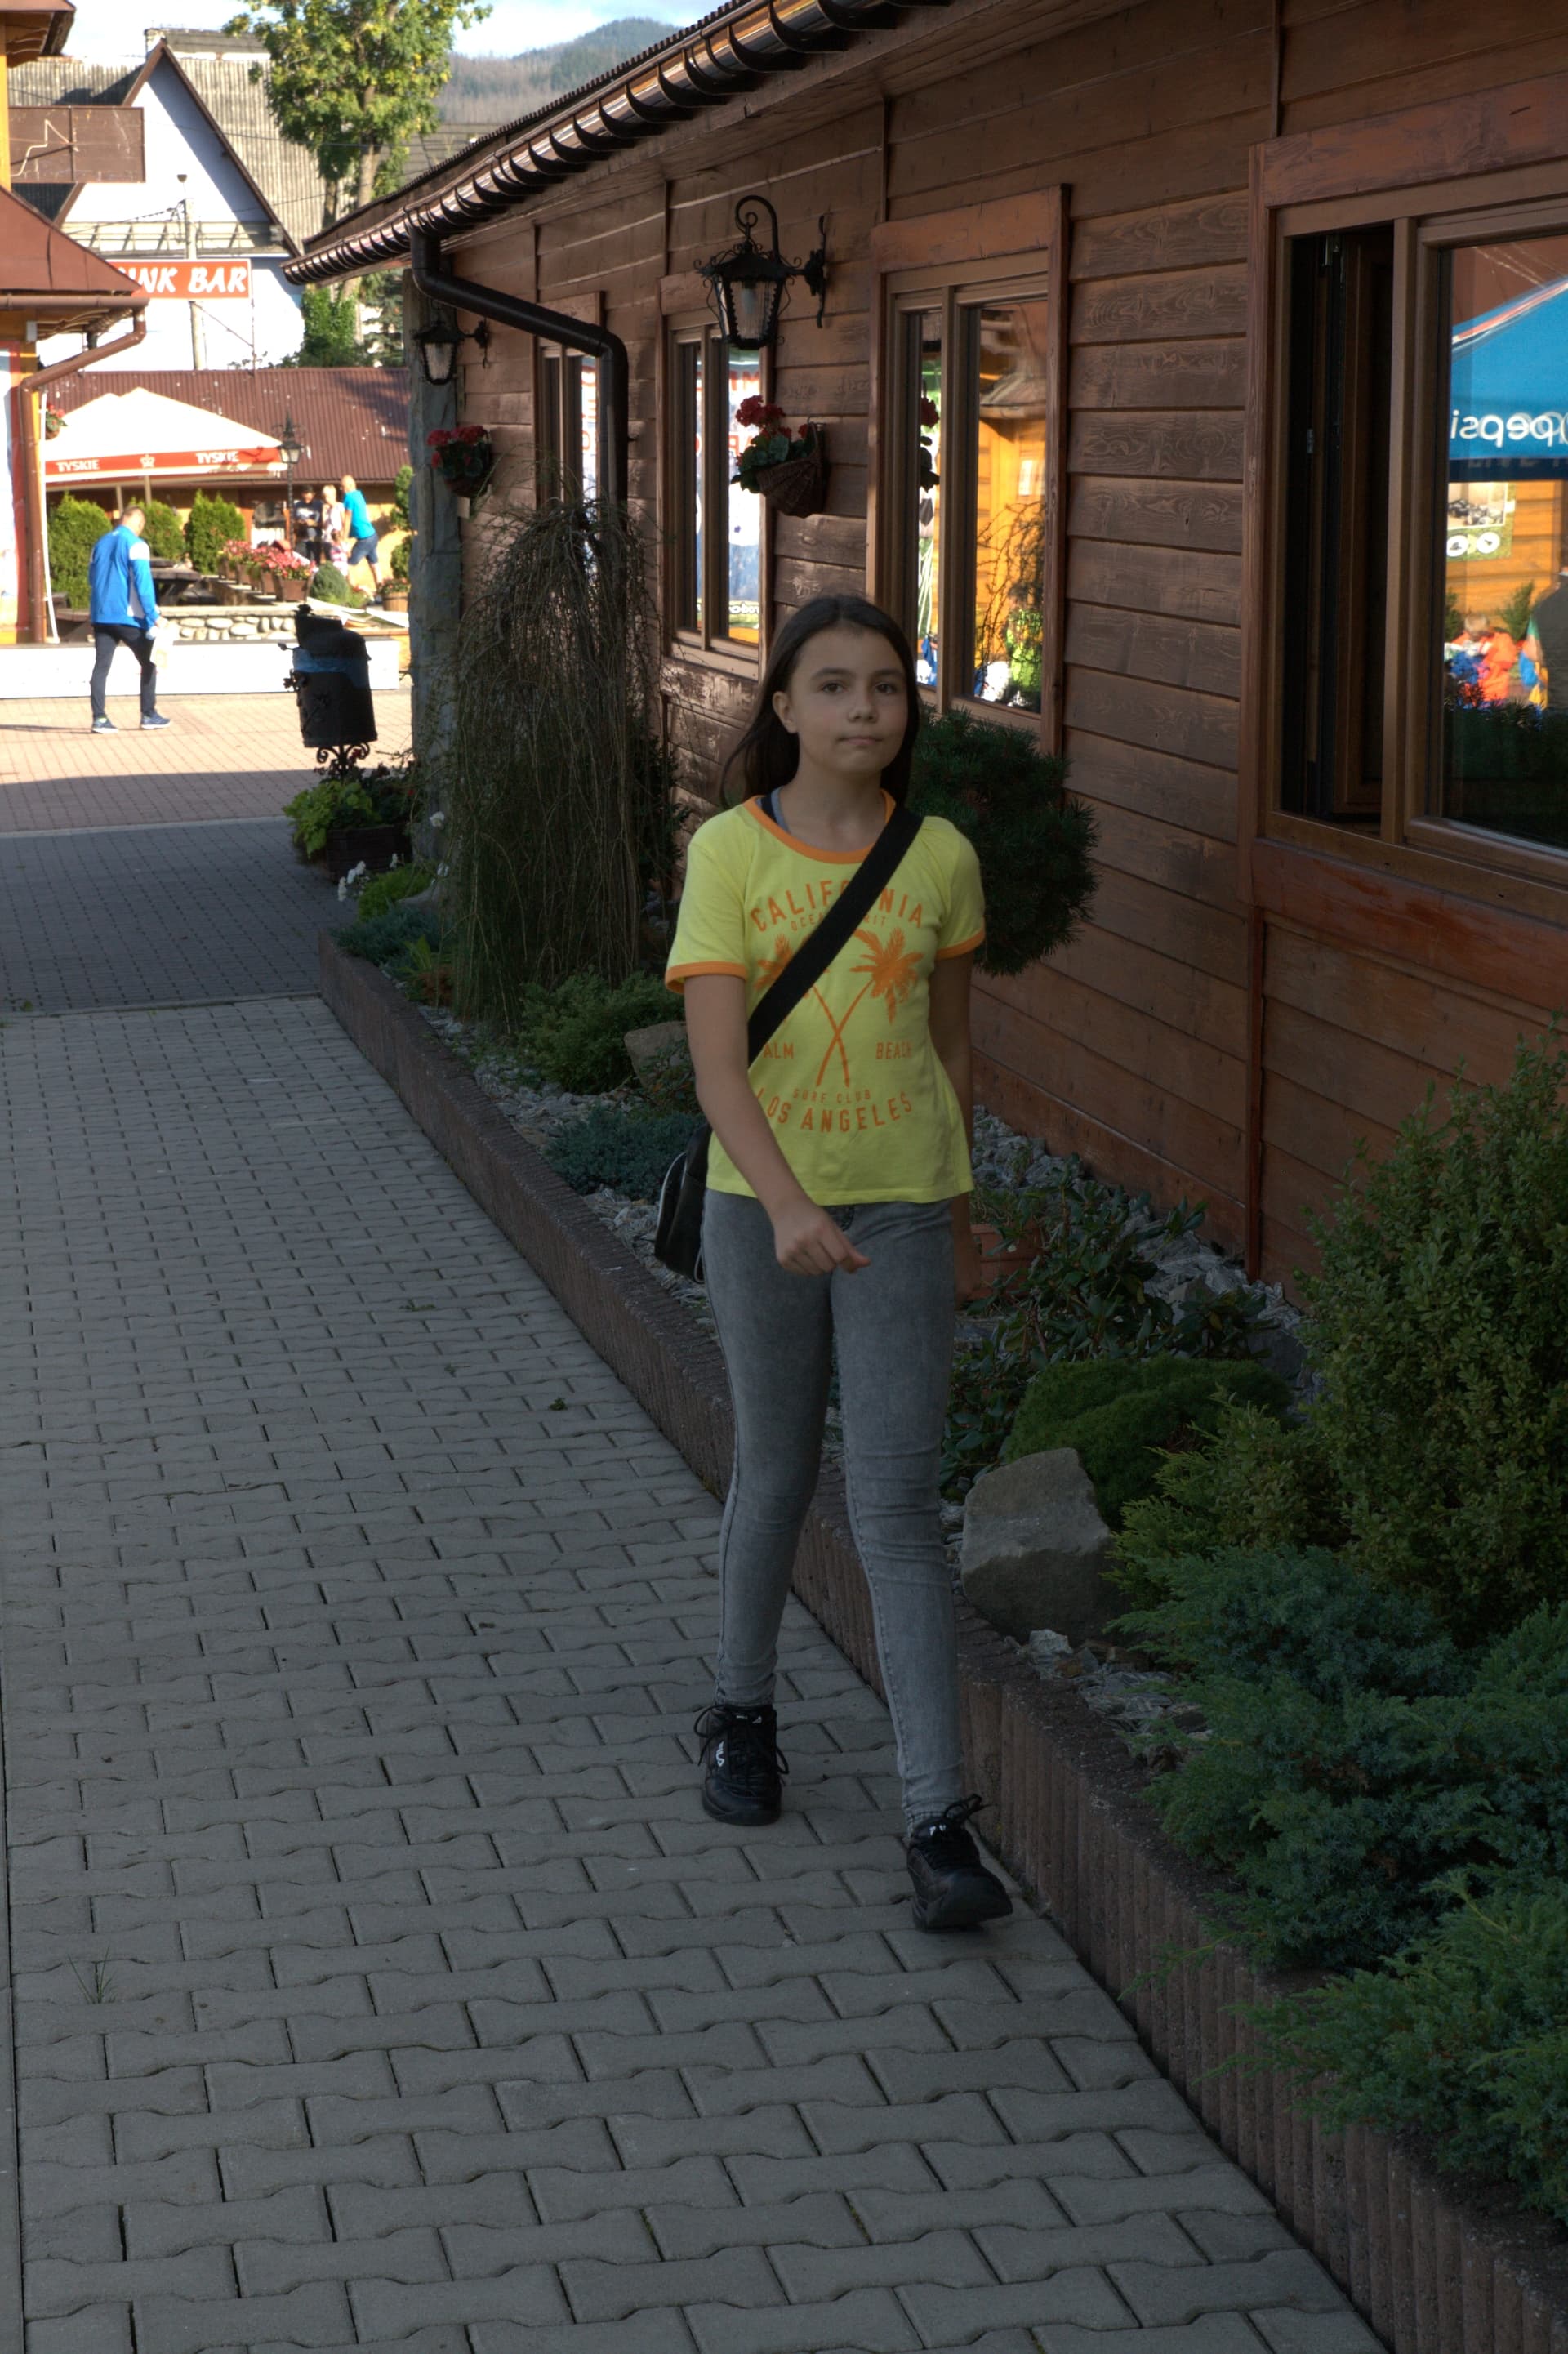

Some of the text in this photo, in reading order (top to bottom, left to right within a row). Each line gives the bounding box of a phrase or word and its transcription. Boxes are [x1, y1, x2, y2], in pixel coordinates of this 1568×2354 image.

[188, 266, 247, 293] BAR
[56, 459, 100, 472] TYSKIE
[196, 451, 239, 464] TYSKIE
[750, 879, 923, 932] CALIFNIA
[790, 912, 824, 931] OCEA
[763, 1042, 794, 1059] ALM
[793, 1088, 871, 1103] SURF CLUB
[800, 1091, 912, 1133] ANGELES
